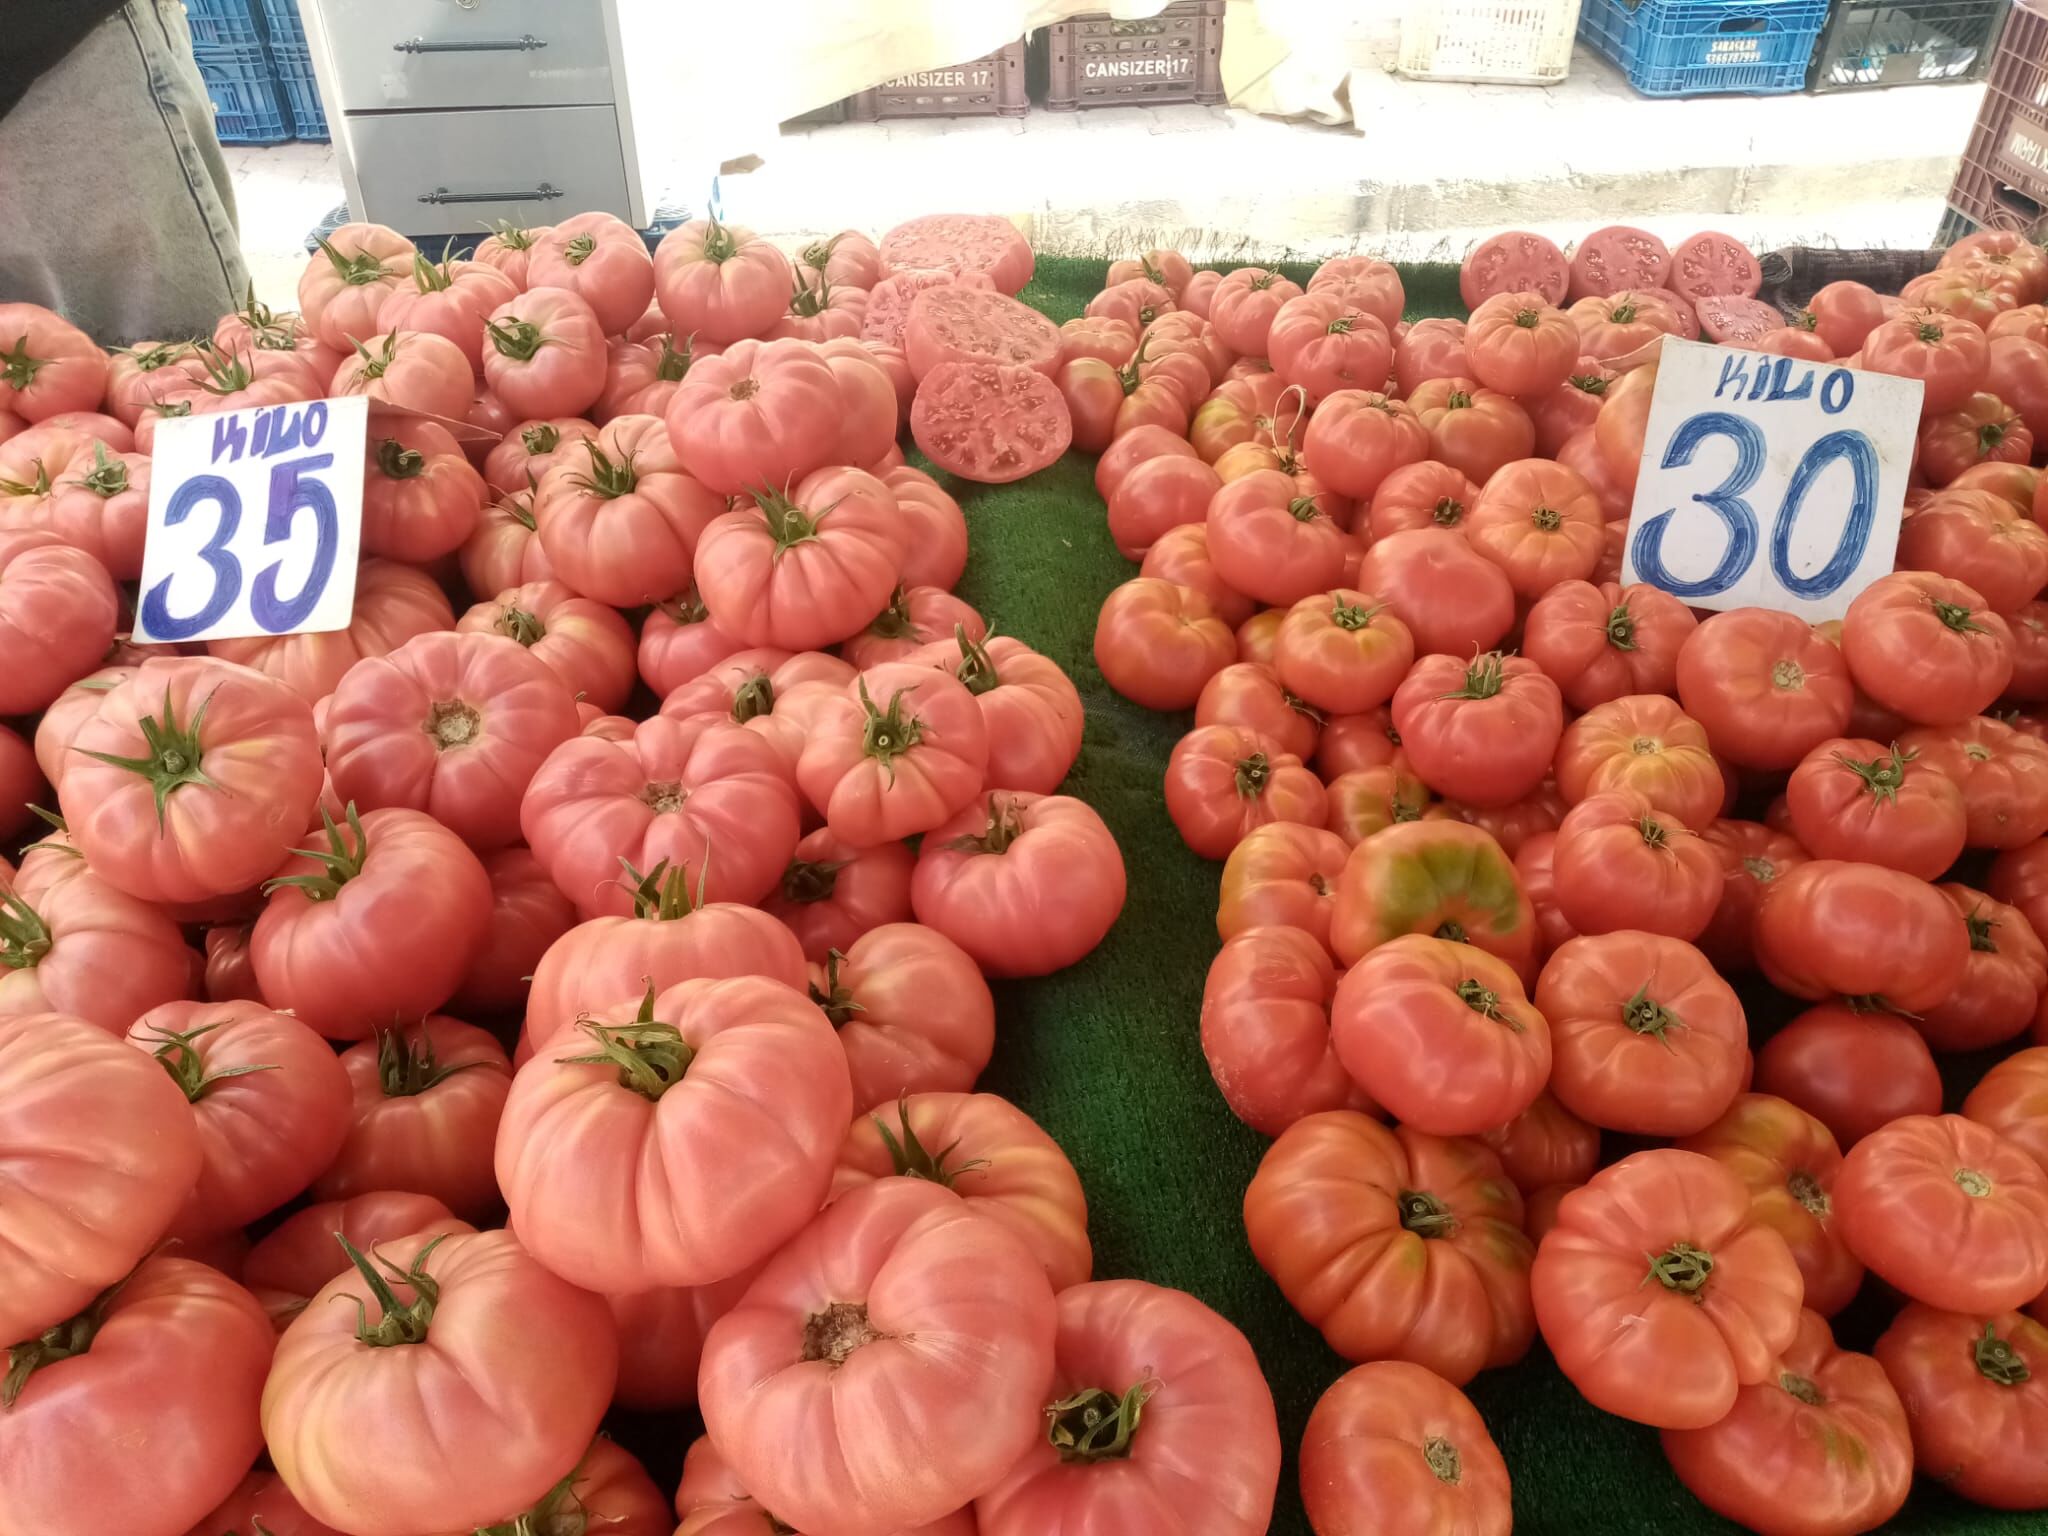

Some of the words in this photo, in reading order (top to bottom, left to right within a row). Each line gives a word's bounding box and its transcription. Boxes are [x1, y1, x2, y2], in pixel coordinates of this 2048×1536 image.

[971, 70, 988, 86] 17
[1085, 60, 1166, 78] CANSIZER
[1171, 58, 1189, 74] 17
[141, 452, 339, 641] 35
[1631, 411, 1880, 601] 30
